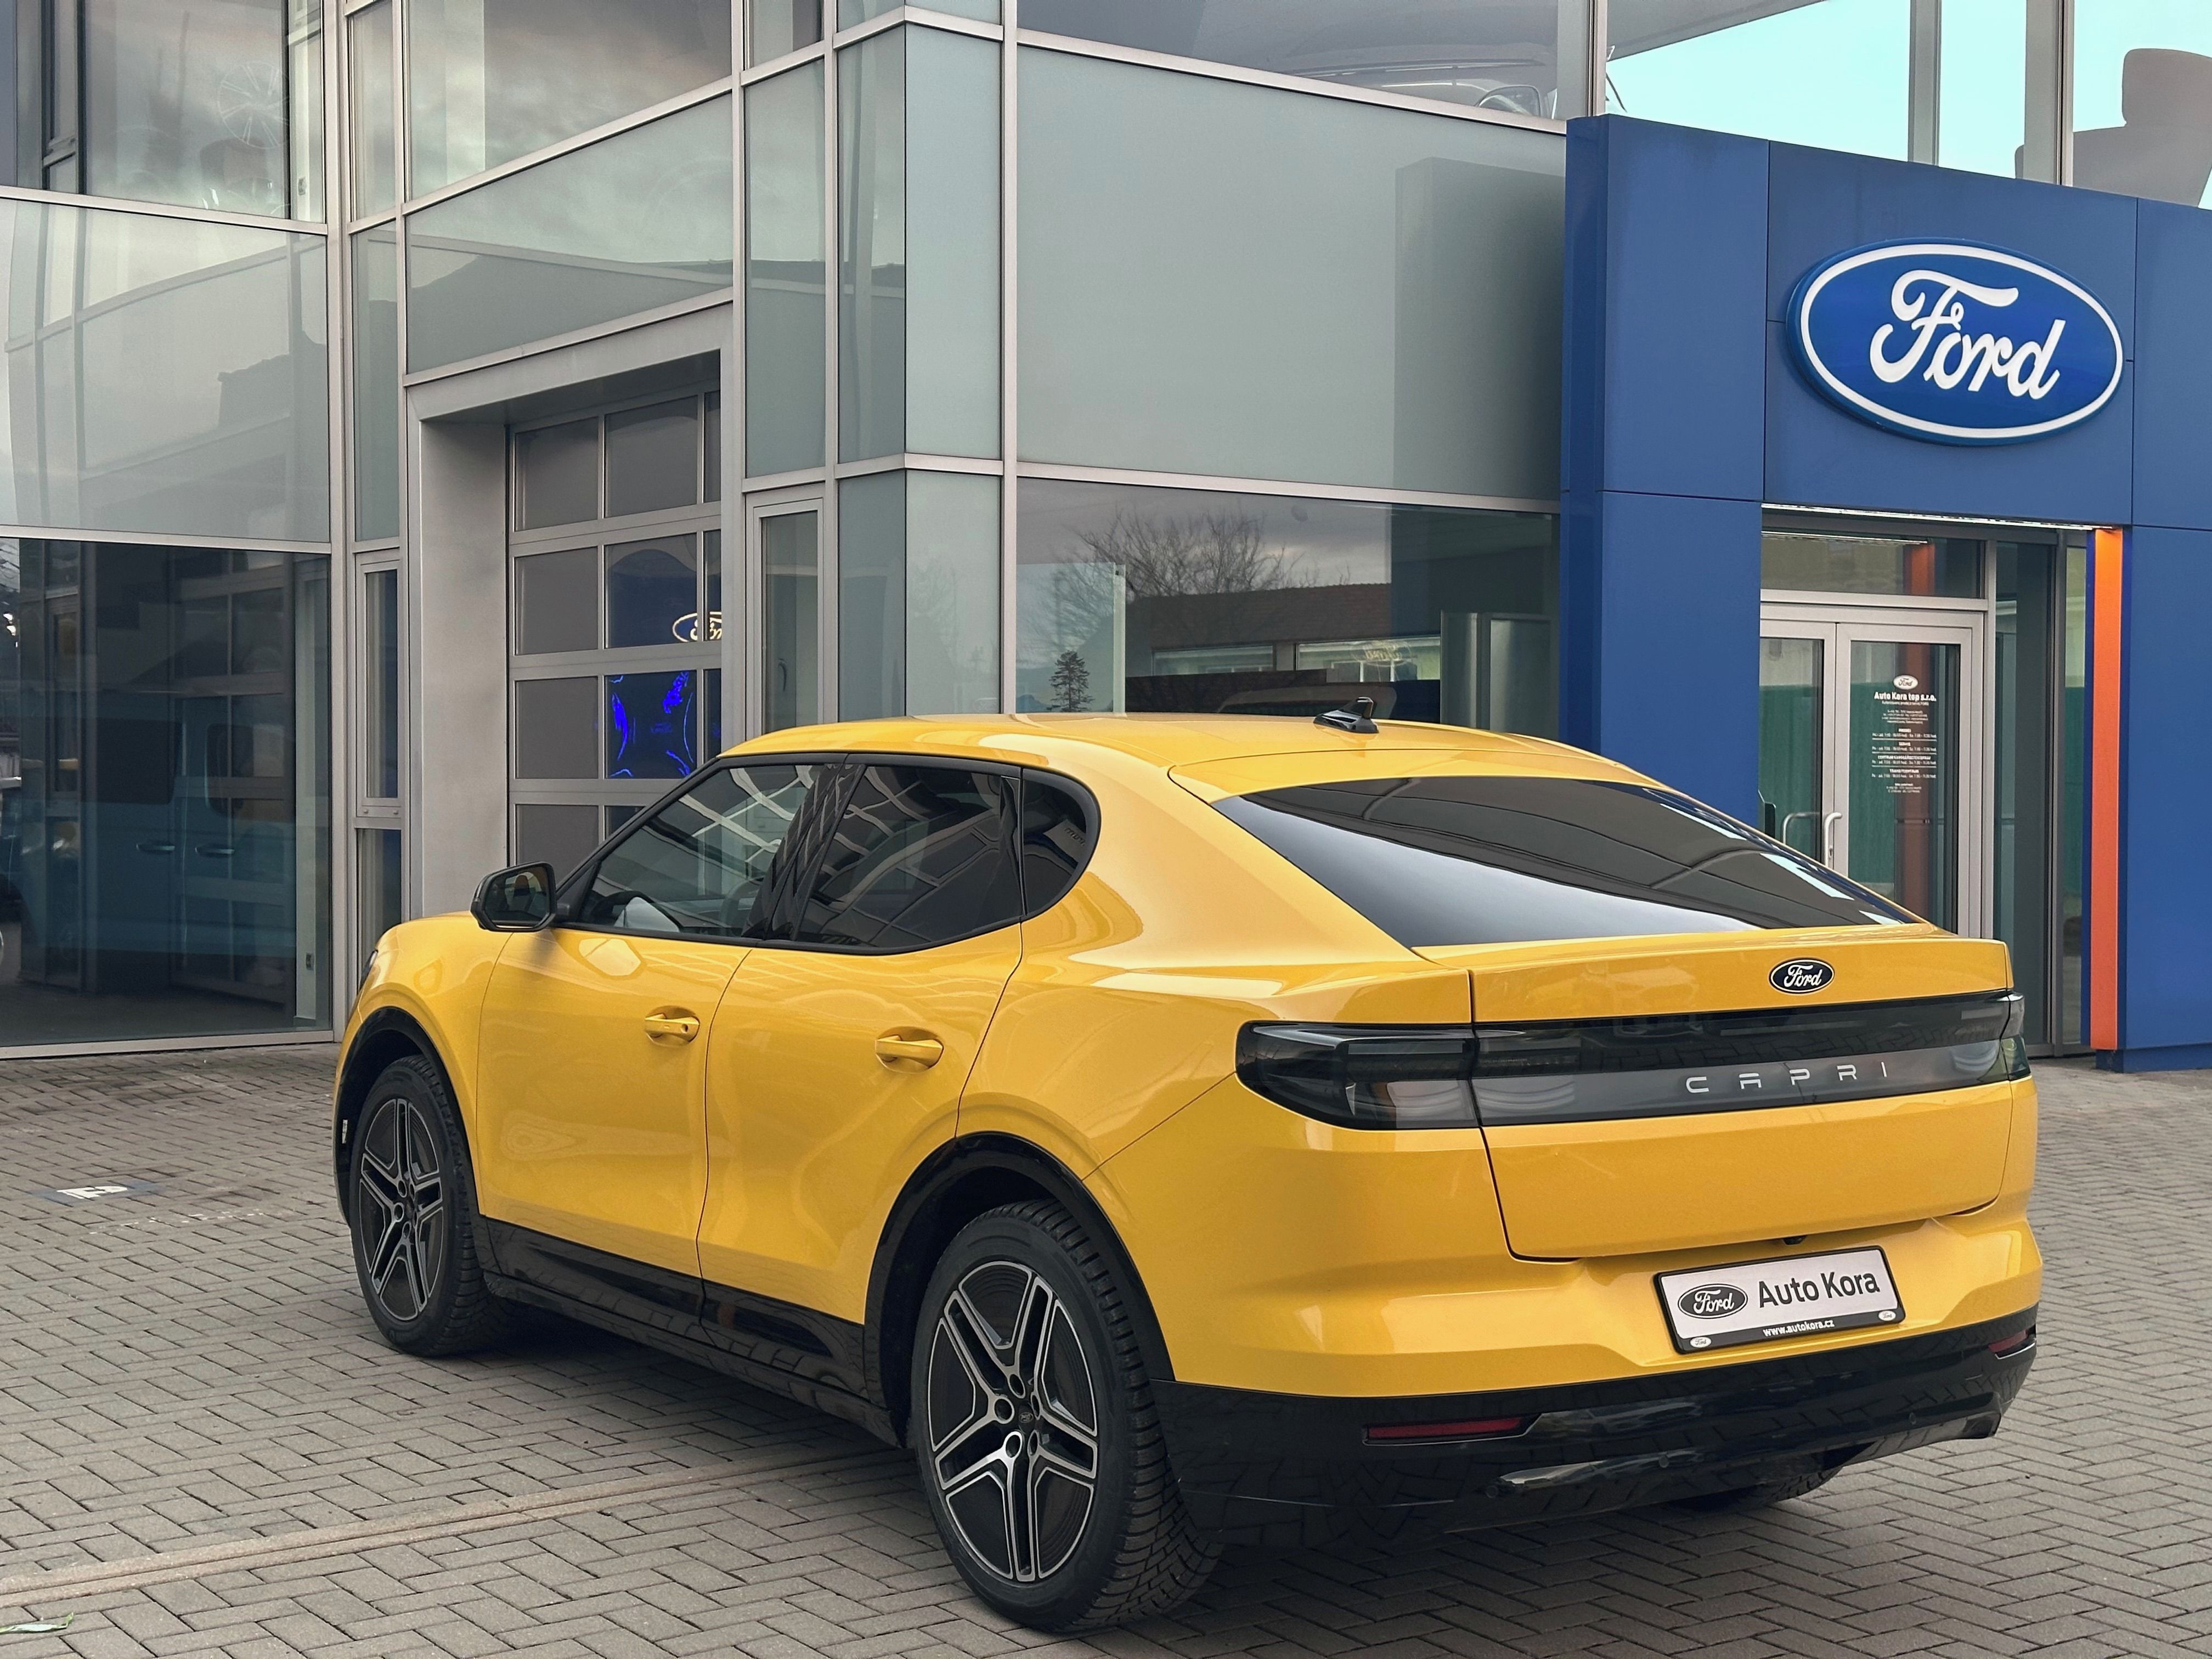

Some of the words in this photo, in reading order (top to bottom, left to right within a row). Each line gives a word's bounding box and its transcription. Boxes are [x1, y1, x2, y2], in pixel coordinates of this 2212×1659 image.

[1870, 269, 2066, 399] Ford
[1874, 692, 1891, 700] Auto
[1892, 692, 1908, 701] Kora
[1908, 693, 1920, 702] top
[1784, 964, 1823, 987] Ford
[1685, 1061, 1888, 1094] CAPRI
[1692, 1288, 1735, 1314] Ford
[1758, 1277, 1820, 1308] Auto
[1820, 1271, 1881, 1299] Kora
[1763, 1320, 1835, 1337] www.autokora.cz
